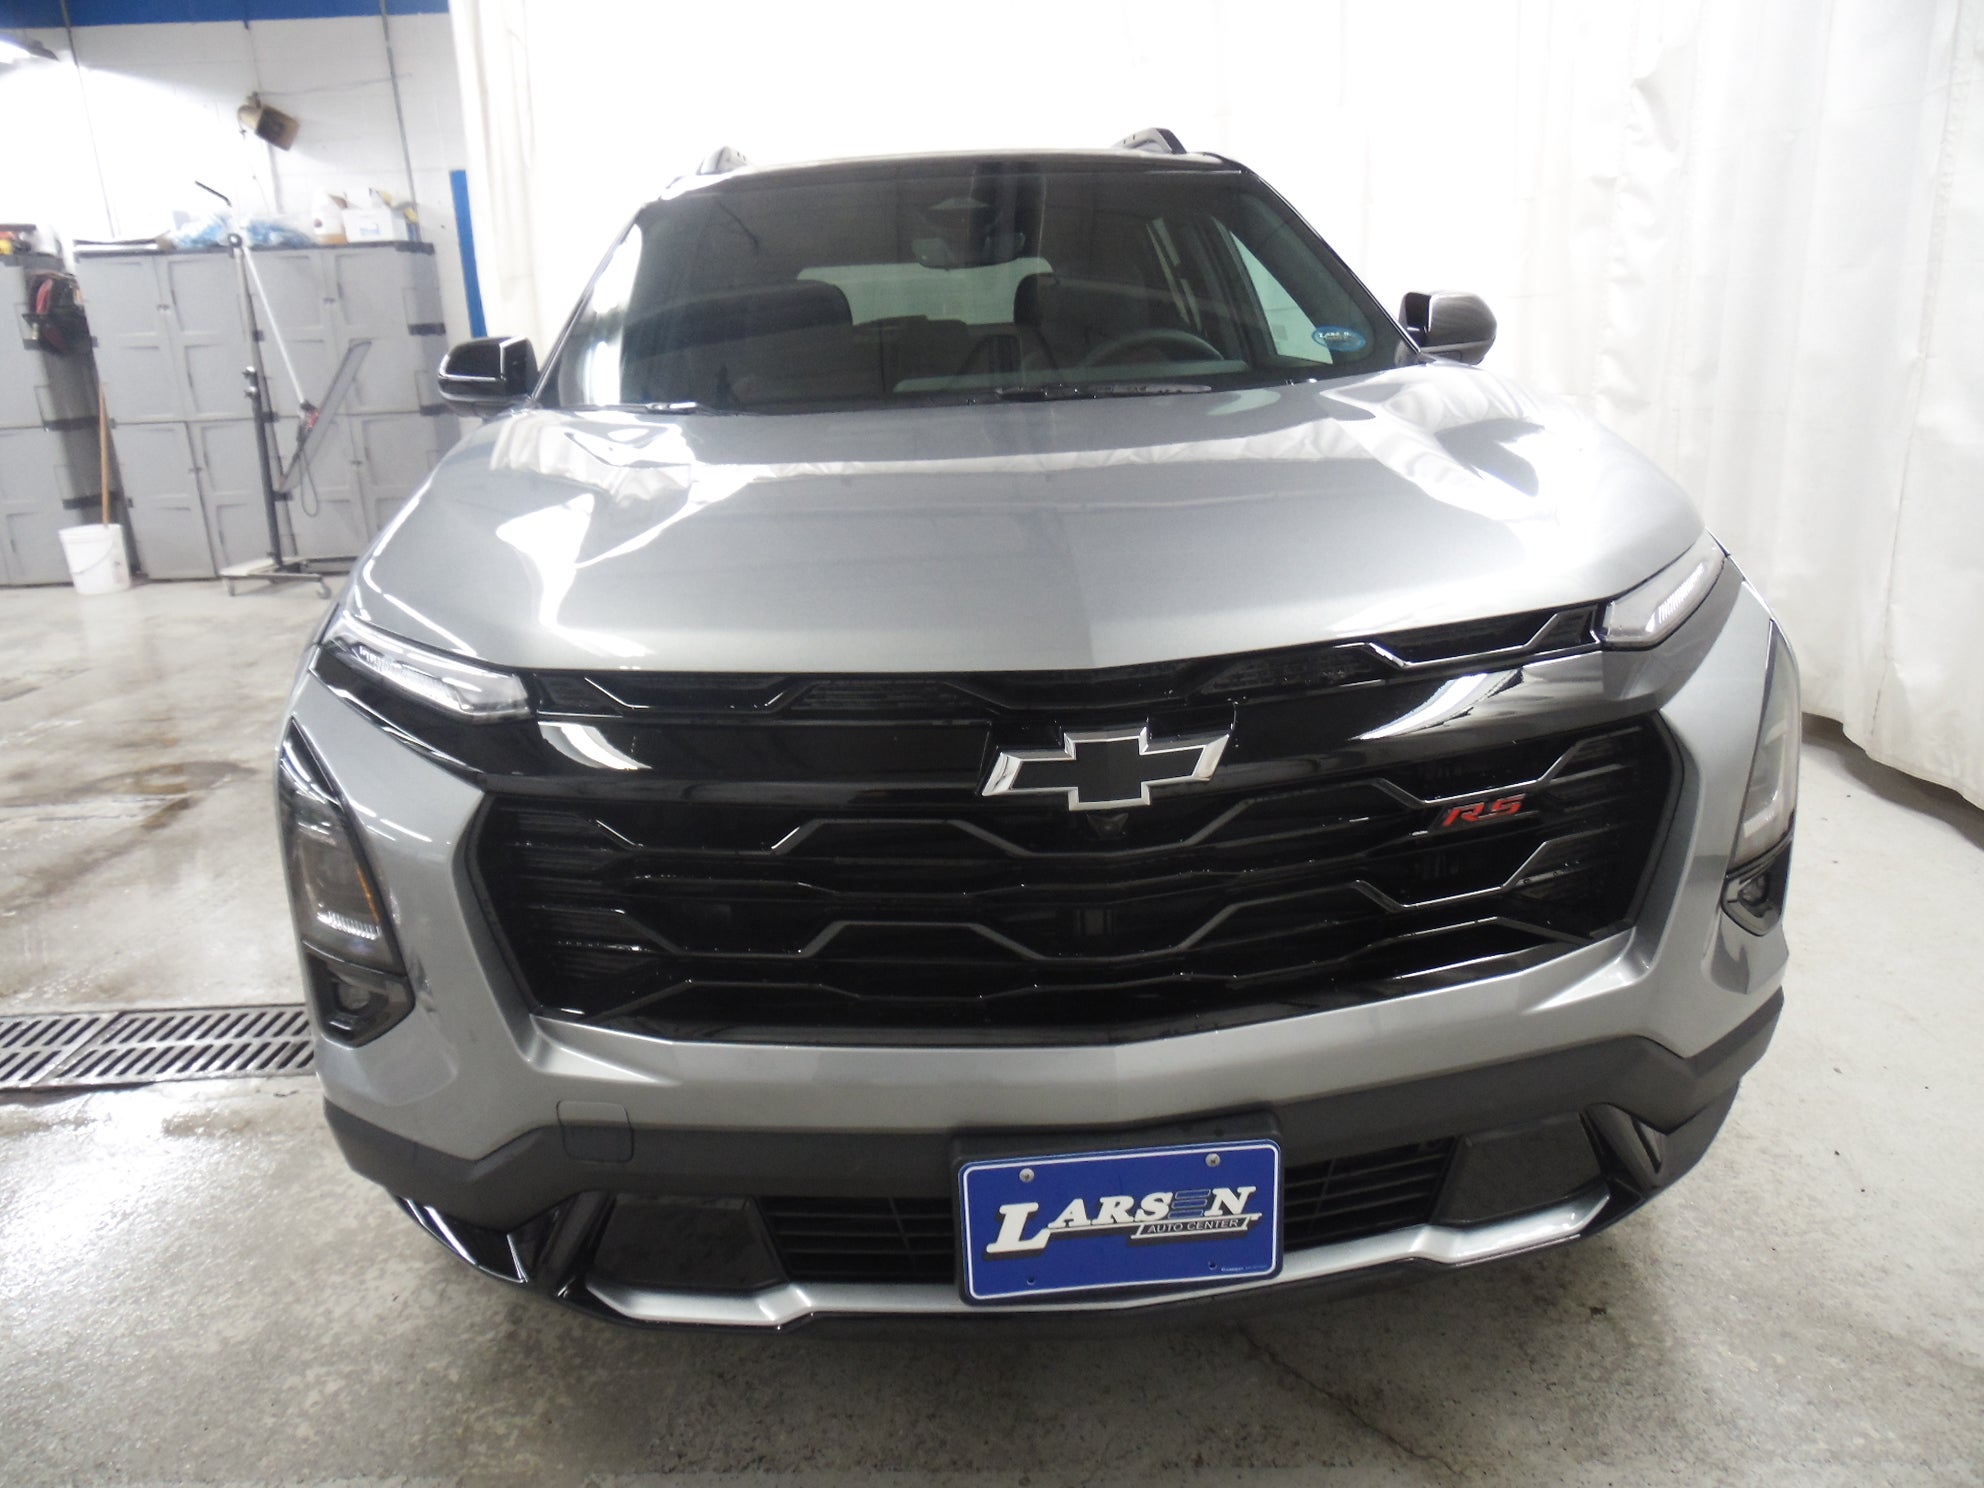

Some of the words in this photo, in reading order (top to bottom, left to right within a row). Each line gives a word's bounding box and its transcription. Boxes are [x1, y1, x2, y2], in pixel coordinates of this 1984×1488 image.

[1442, 793, 1526, 827] RS
[986, 1186, 1257, 1254] LARSEN
[1147, 1222, 1183, 1234] AUTO
[1187, 1218, 1240, 1231] CENTER
